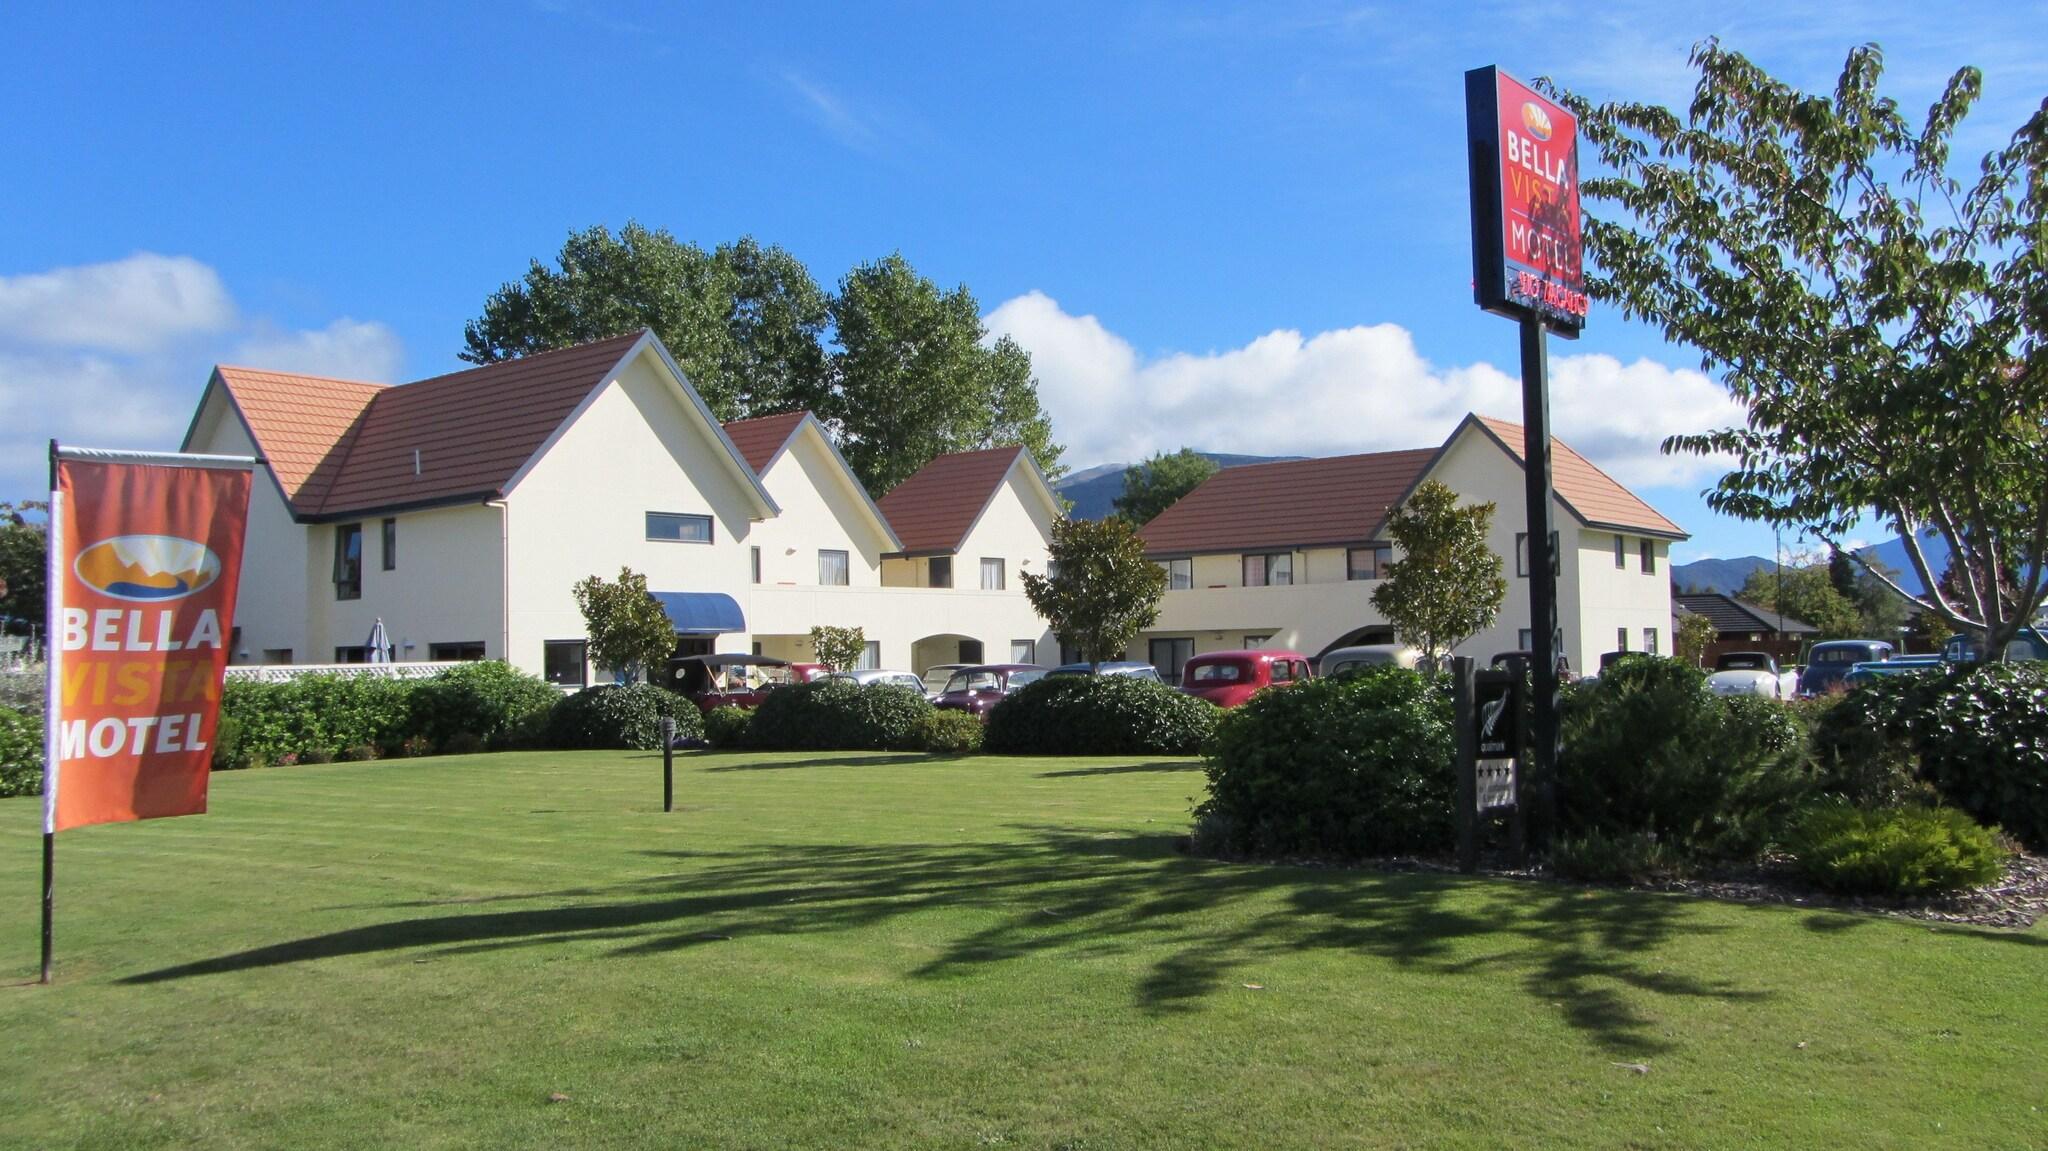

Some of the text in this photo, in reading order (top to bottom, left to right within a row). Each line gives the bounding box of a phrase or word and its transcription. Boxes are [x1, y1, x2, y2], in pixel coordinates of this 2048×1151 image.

[1507, 129, 1568, 189] BELLA
[1511, 220, 1573, 275] MOTEL
[62, 607, 222, 652] BELLA
[62, 660, 217, 707] VISTA
[60, 712, 207, 761] MOTEL
